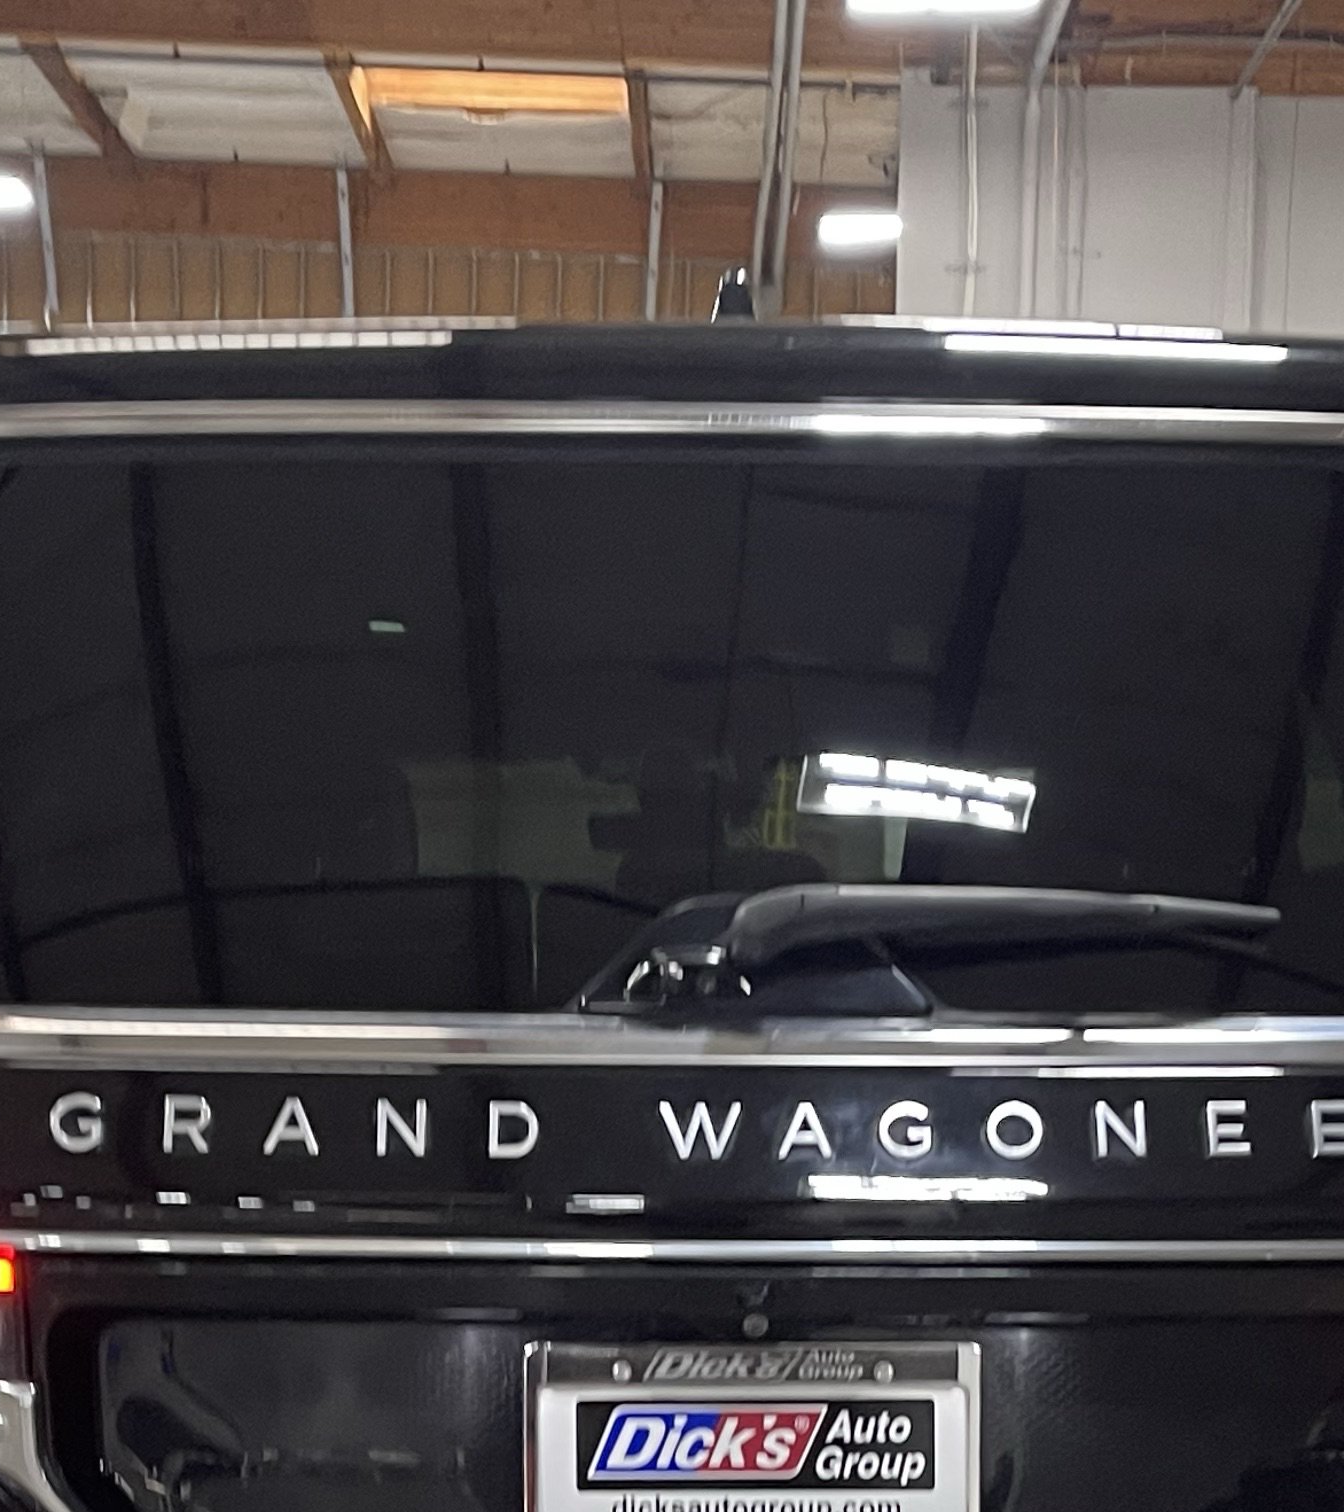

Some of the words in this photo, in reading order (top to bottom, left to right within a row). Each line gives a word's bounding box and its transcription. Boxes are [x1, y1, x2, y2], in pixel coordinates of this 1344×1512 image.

[49, 1092, 540, 1159] GRAND
[606, 1413, 797, 1470] Dick's
[825, 1408, 912, 1444] Auto
[814, 1444, 926, 1487] Group
